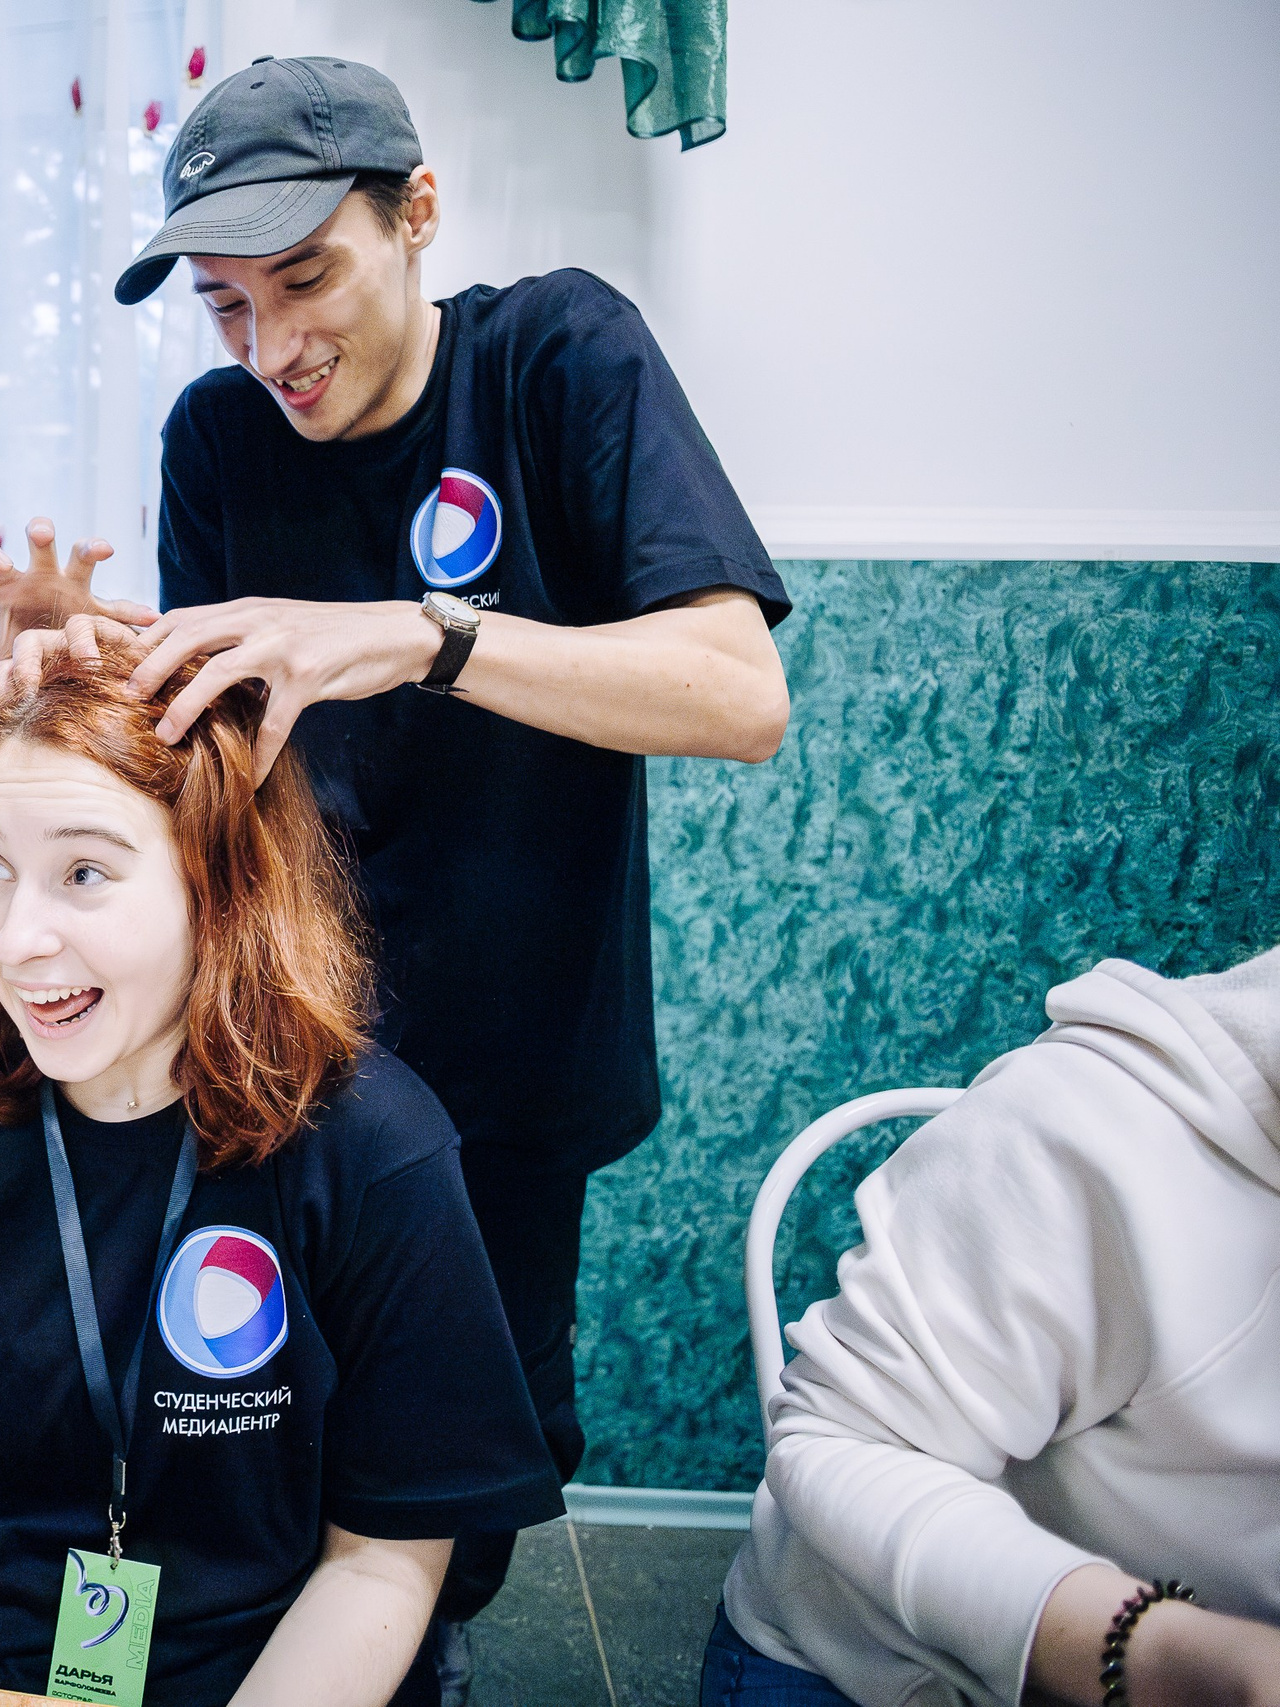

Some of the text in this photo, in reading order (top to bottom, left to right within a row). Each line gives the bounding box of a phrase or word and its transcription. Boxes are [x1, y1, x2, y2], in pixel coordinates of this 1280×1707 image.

[154, 1386, 291, 1412] СТУДЕНЧЕСКИЙ
[162, 1413, 280, 1437] МЕДИАЦЕНТР
[126, 1579, 155, 1670] MEDIA
[56, 1664, 113, 1686] ДАРЬЯ
